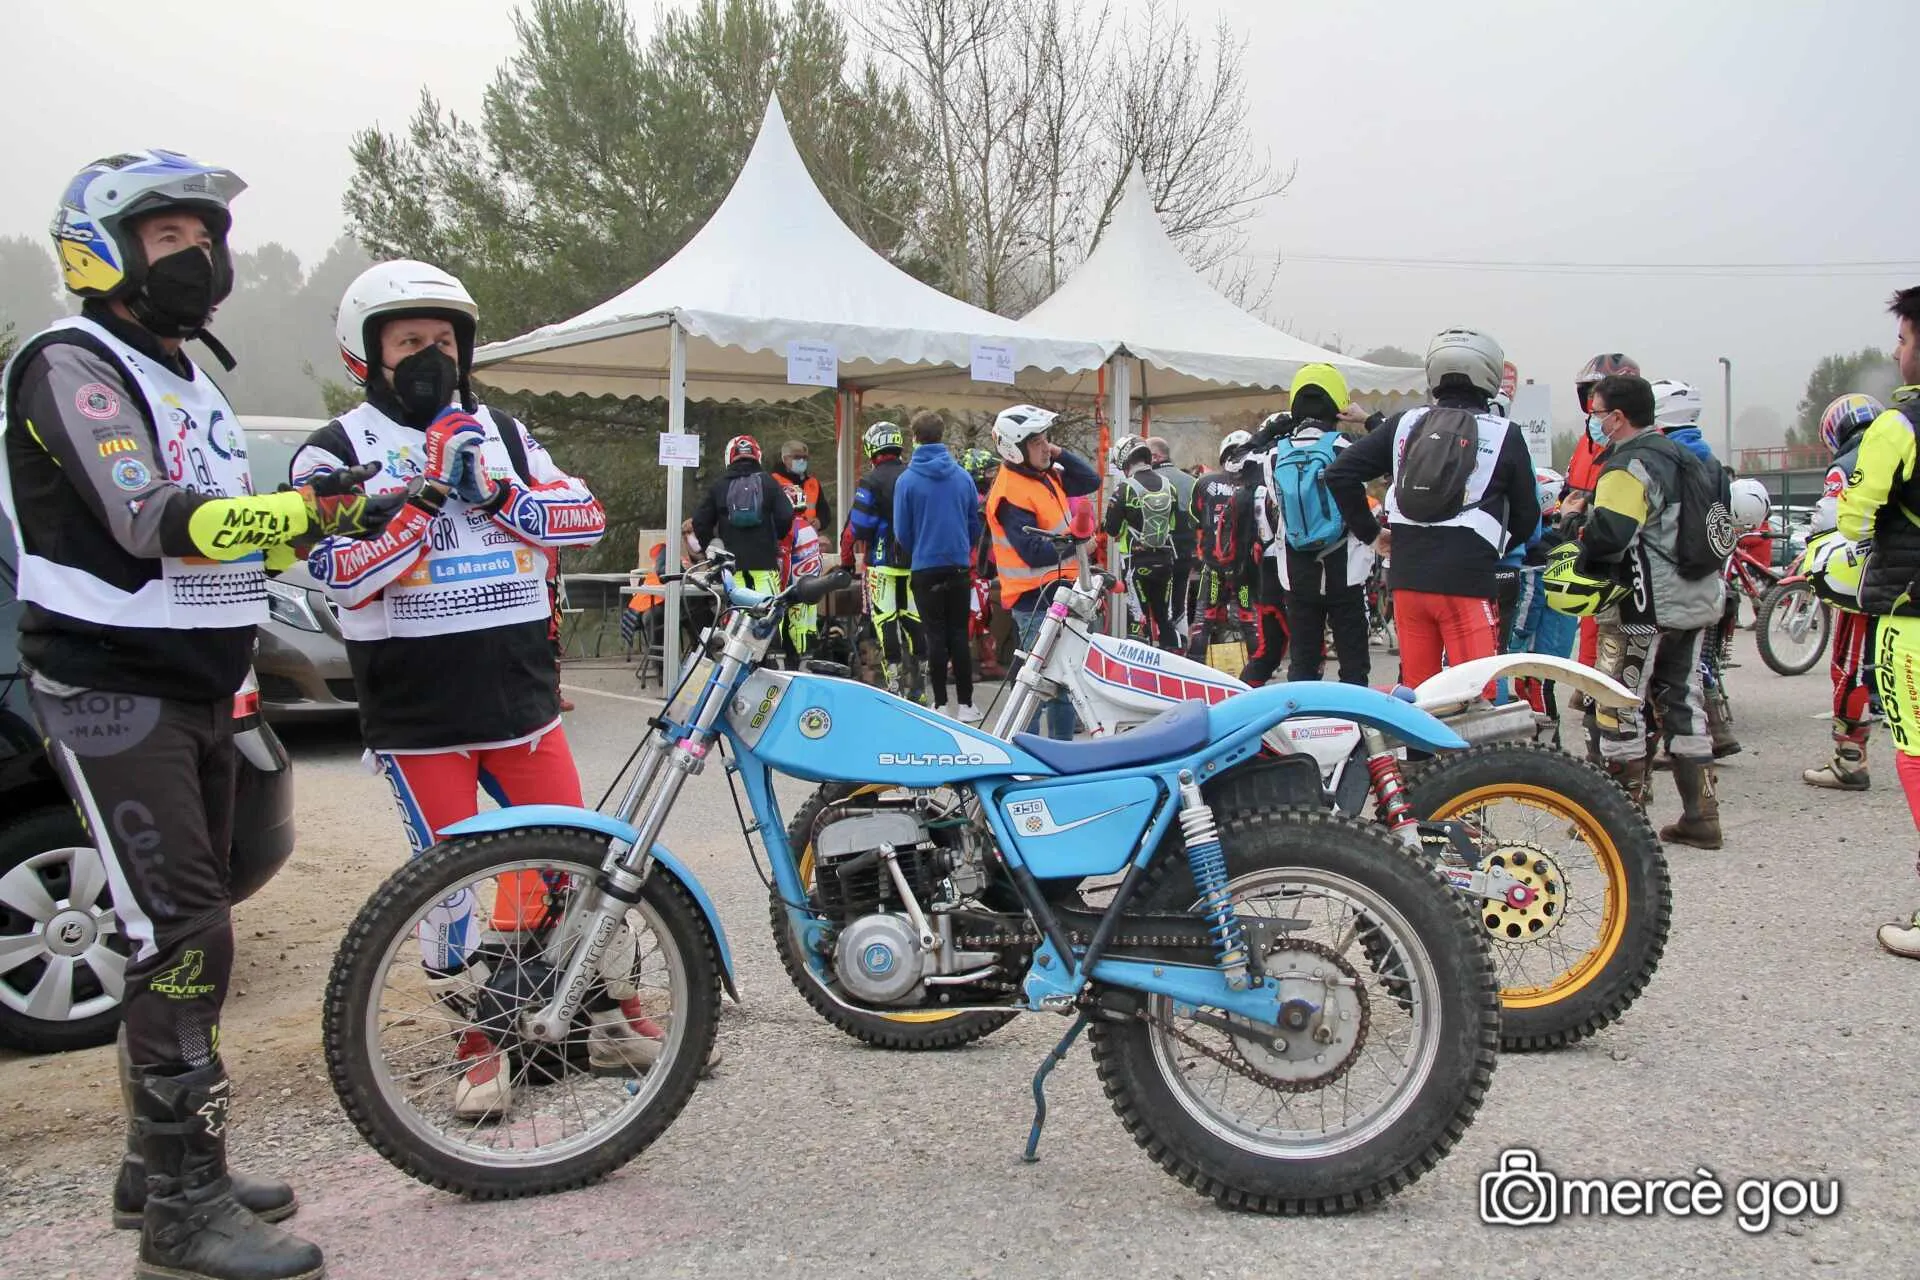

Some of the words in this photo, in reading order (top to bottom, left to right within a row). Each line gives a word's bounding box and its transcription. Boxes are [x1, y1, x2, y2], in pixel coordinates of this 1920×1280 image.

[426, 431, 443, 472] AMAHA
[339, 530, 399, 576] YAMAHA
[436, 565, 455, 577] La
[458, 557, 510, 574] Marató
[1116, 642, 1160, 666] YAMAHA
[879, 753, 984, 766] BULTACO
[1013, 800, 1043, 816] 350
[558, 914, 618, 1022] BULTACO
[150, 983, 216, 994] ROVIRA
